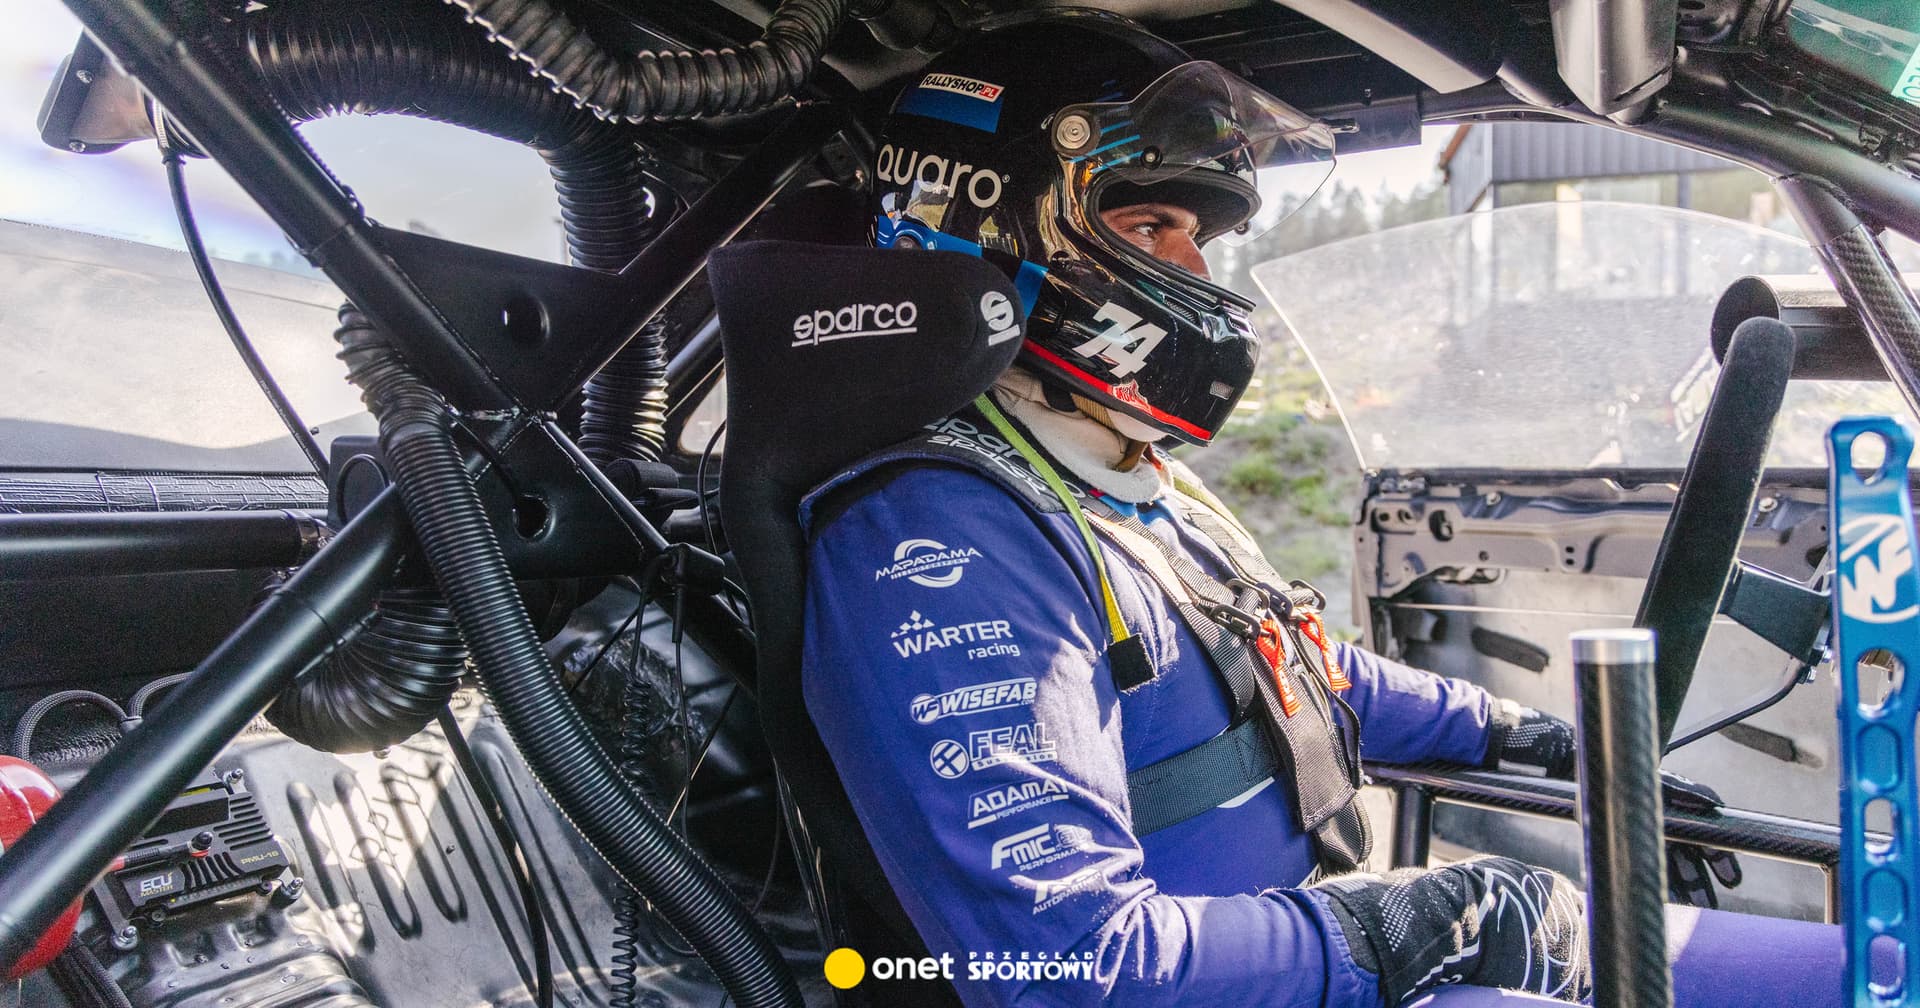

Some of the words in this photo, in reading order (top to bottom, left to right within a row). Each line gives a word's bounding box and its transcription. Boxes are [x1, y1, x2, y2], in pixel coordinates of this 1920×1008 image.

[792, 301, 917, 347] sparco
[1072, 301, 1168, 378] 74
[875, 547, 983, 581] MAPADAMA
[893, 620, 1013, 659] WARTER
[967, 642, 1021, 660] racing
[941, 682, 1038, 713] WISEFAB
[969, 722, 1056, 761] FEAL
[140, 872, 174, 892] ECU
